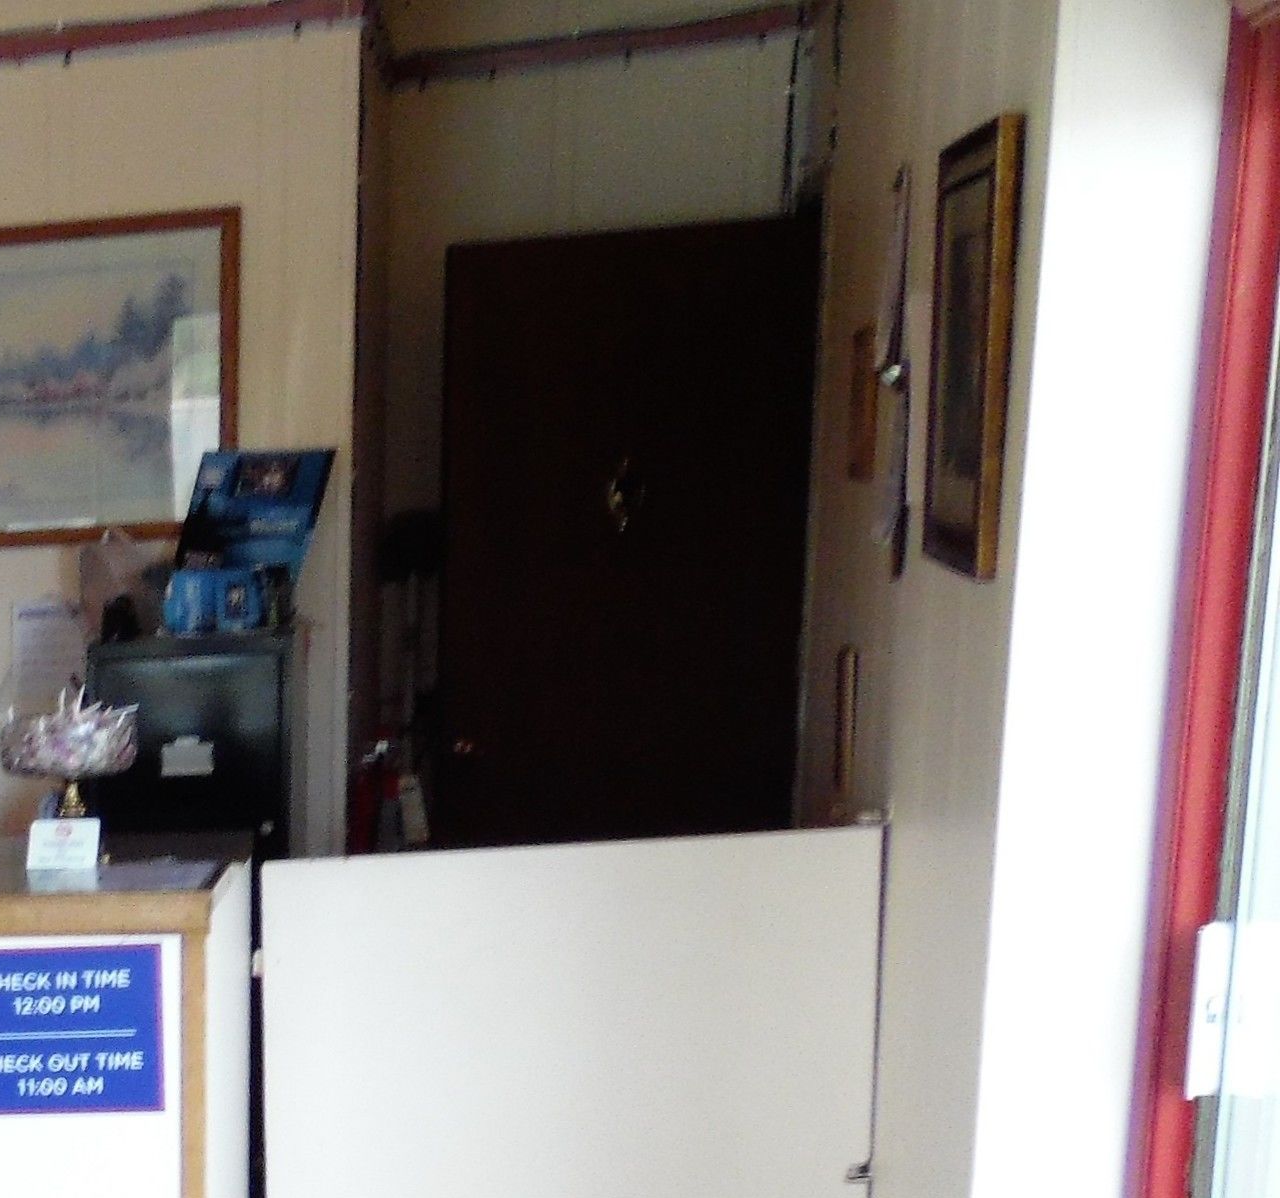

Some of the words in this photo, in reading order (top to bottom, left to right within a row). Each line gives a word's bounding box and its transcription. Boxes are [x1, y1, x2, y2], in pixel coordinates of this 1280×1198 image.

[56, 970, 78, 990] IN
[82, 968, 131, 989] TIME
[12, 995, 66, 1016] 12:00
[69, 994, 101, 1014] PM
[47, 1052, 91, 1073] OUT
[95, 1051, 144, 1071] TIME
[16, 1077, 68, 1097] 11:00
[71, 1076, 104, 1096] AM
